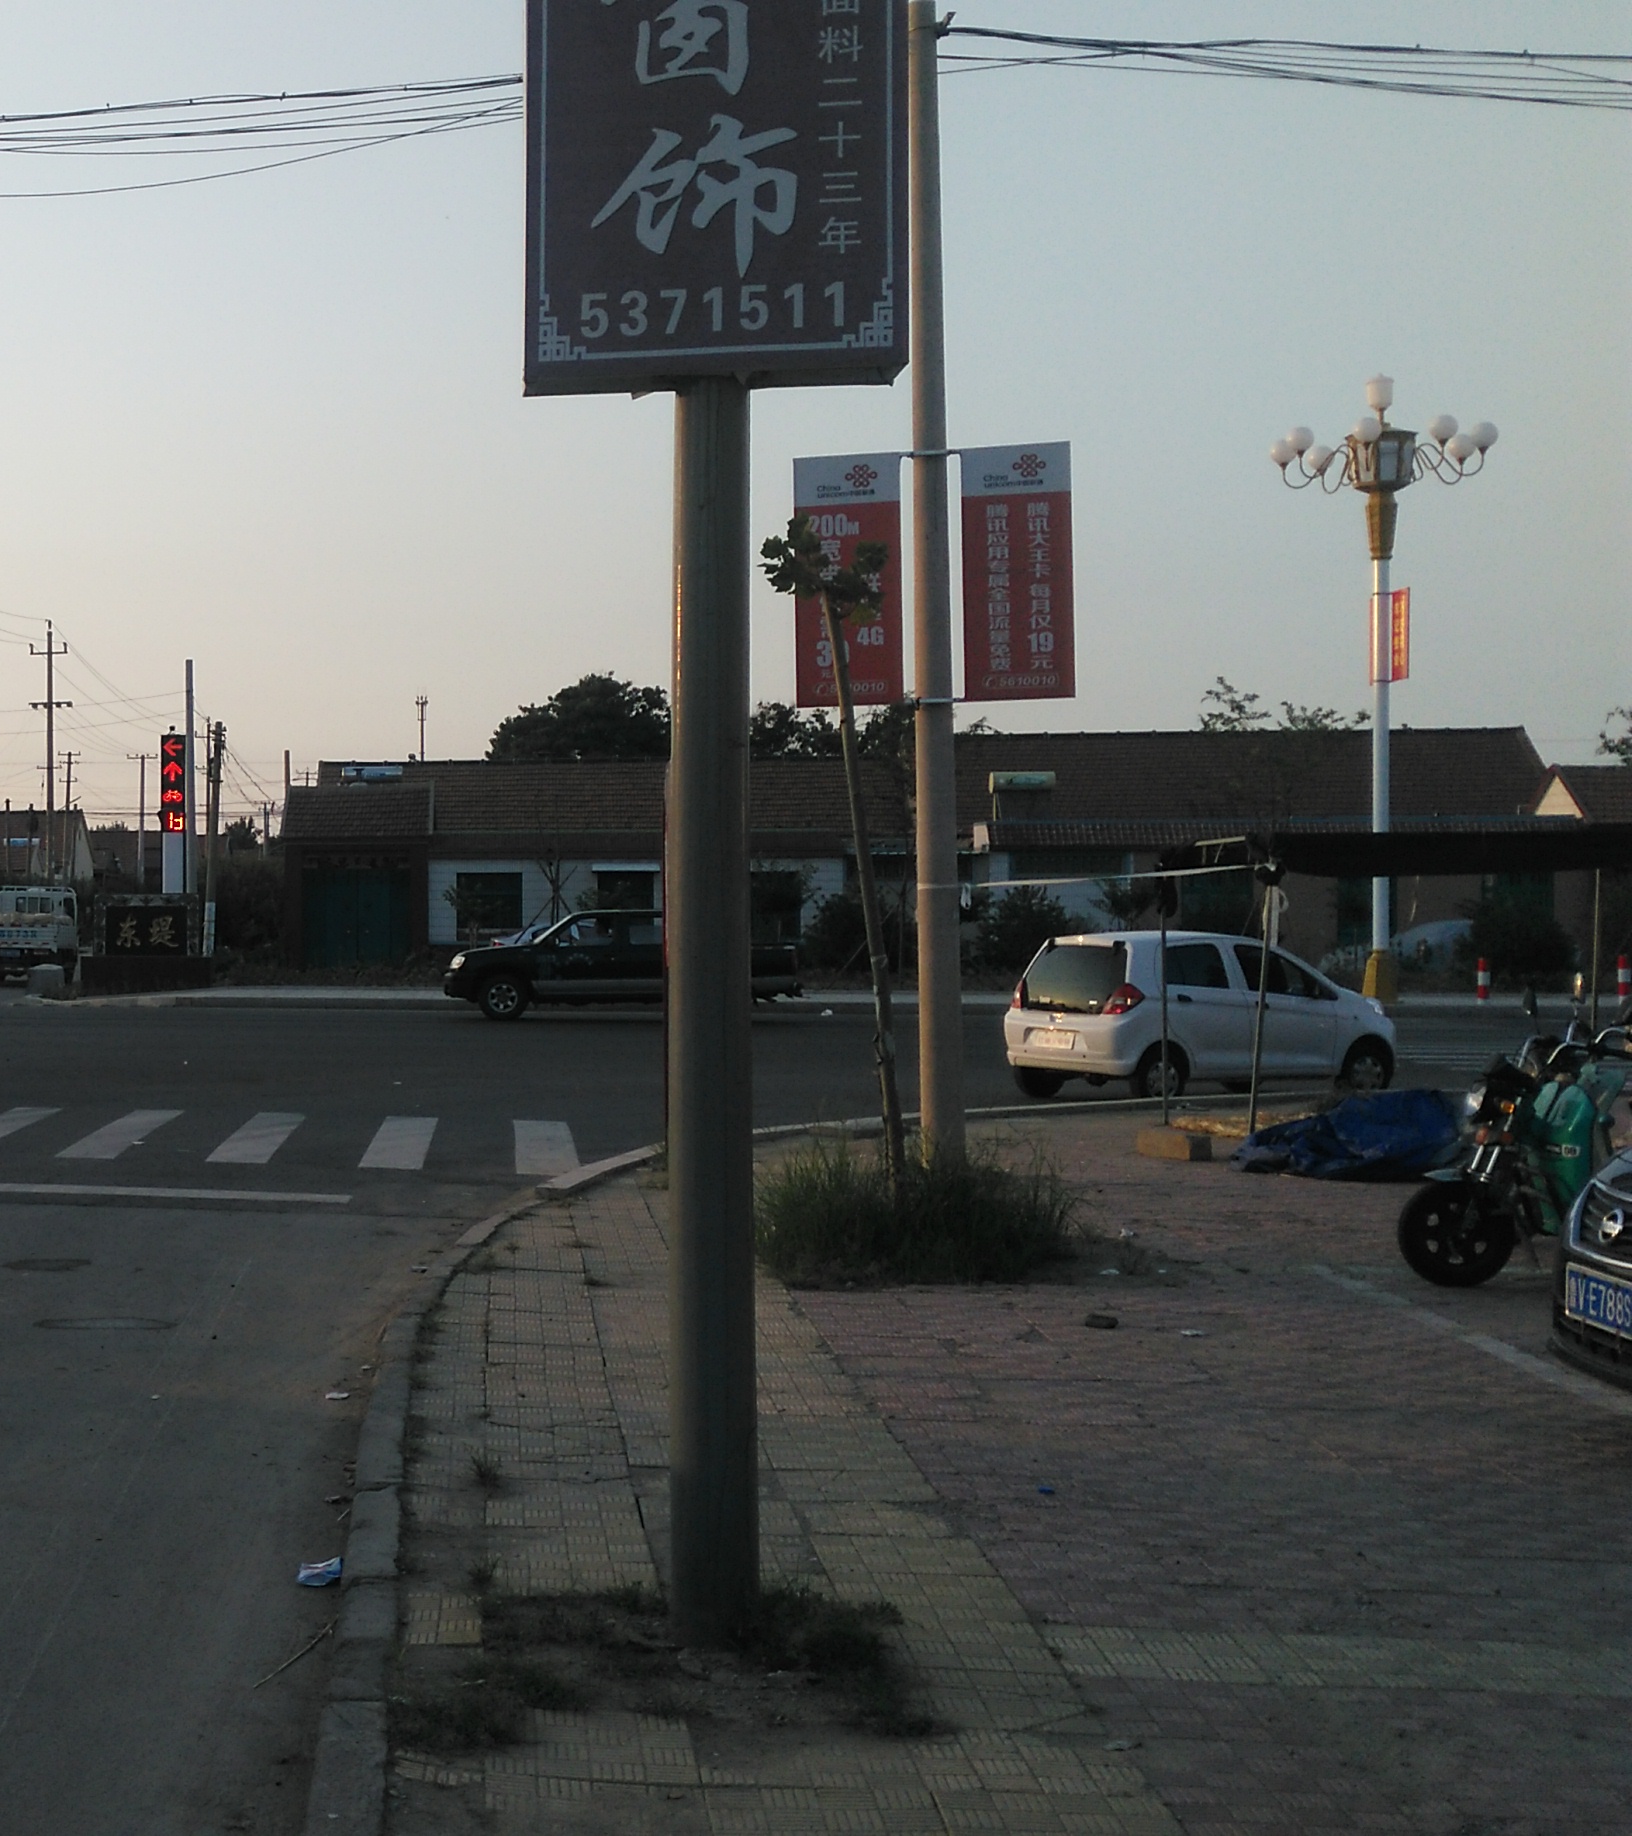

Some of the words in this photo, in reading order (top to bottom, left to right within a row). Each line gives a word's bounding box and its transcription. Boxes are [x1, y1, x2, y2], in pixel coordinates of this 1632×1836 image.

[579, 281, 846, 338] 5371511
[983, 474, 1008, 482] China
[1027, 502, 1051, 578] 腾讯大王卡
[857, 626, 885, 646] 4G
[1028, 583, 1054, 670] 每月仅19元
[816, 640, 850, 668] 3
[830, 682, 885, 694] 50010
[999, 675, 1056, 687] 5610010
